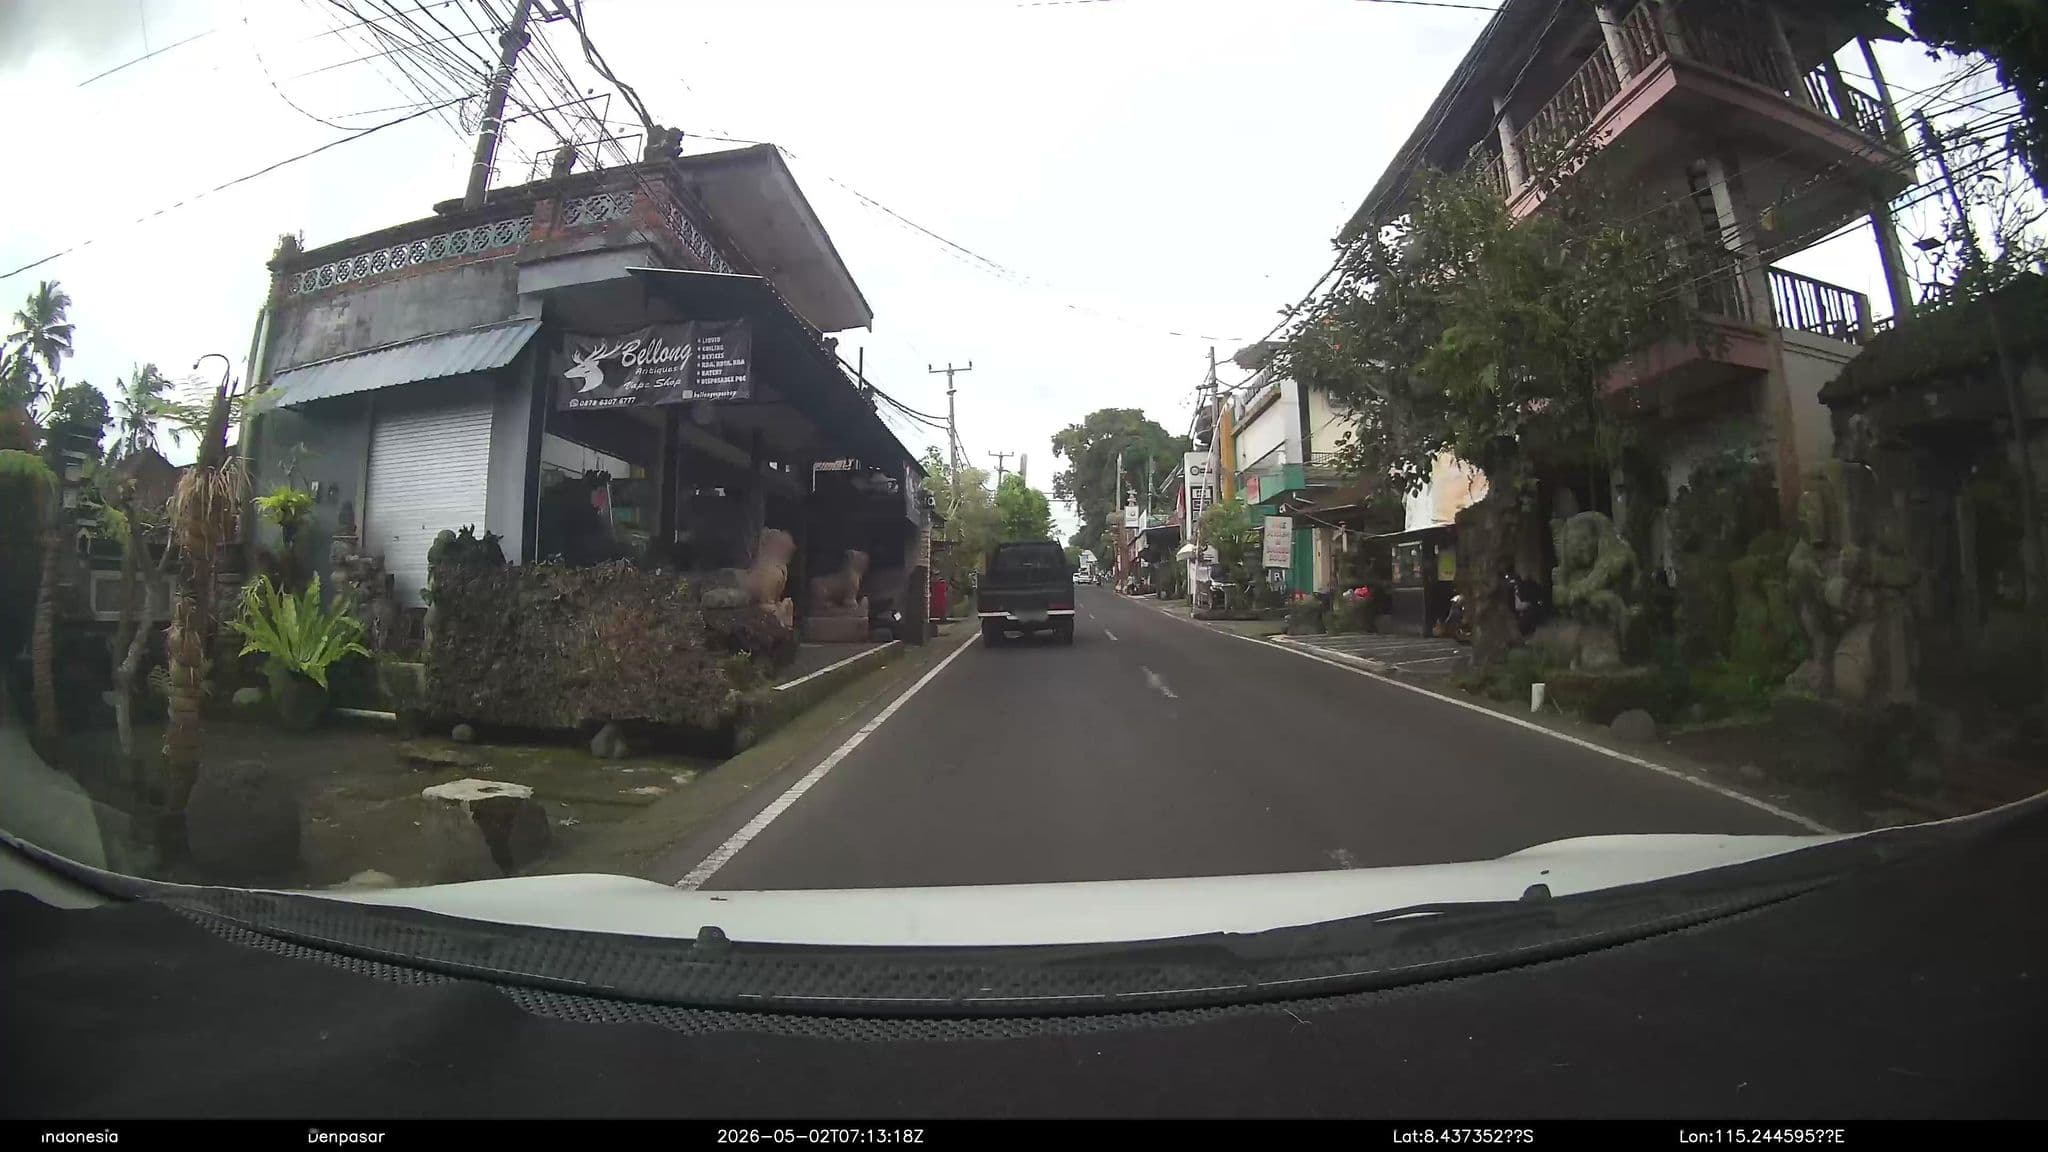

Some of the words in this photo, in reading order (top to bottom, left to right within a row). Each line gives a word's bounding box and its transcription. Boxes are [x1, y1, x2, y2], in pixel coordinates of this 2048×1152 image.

[621, 337, 693, 370] Bellong
[635, 367, 679, 376] Antiques
[623, 381, 651, 391] Vape
[653, 378, 682, 389] Shop
